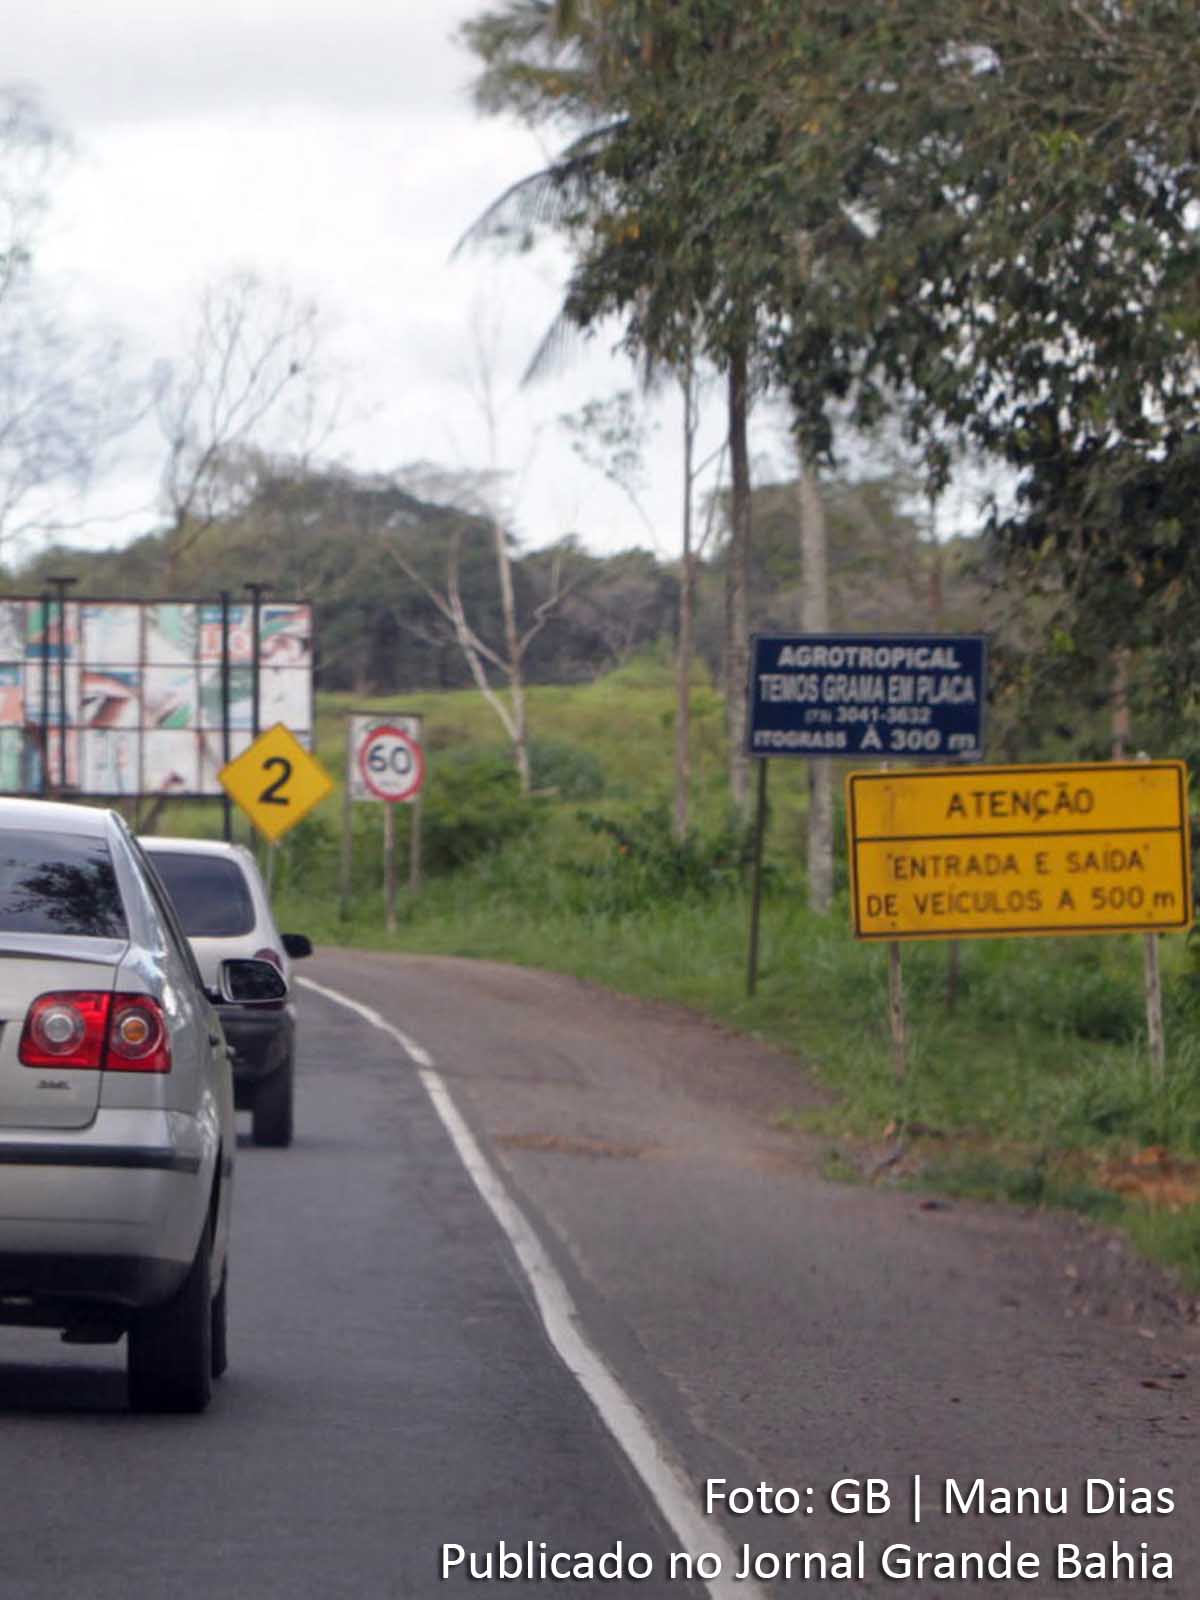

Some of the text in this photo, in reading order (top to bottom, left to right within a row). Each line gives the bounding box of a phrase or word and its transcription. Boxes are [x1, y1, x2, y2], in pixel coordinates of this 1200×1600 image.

[777, 646, 961, 669] AGROTROPICAL
[759, 674, 819, 701] TEMOS
[822, 674, 884, 702] GRAMA
[917, 675, 976, 702] PLACA
[890, 729, 941, 750] 300
[948, 733, 976, 749] m
[368, 744, 412, 775] 60
[258, 757, 293, 805] 2
[946, 782, 1095, 821] ATENÇÃO
[893, 852, 1020, 880] ENTRADA
[1035, 851, 1051, 875] E
[866, 893, 898, 918] DE
[1057, 889, 1075, 911] A
[1092, 885, 1145, 911] 500
[1153, 891, 1175, 908] m
